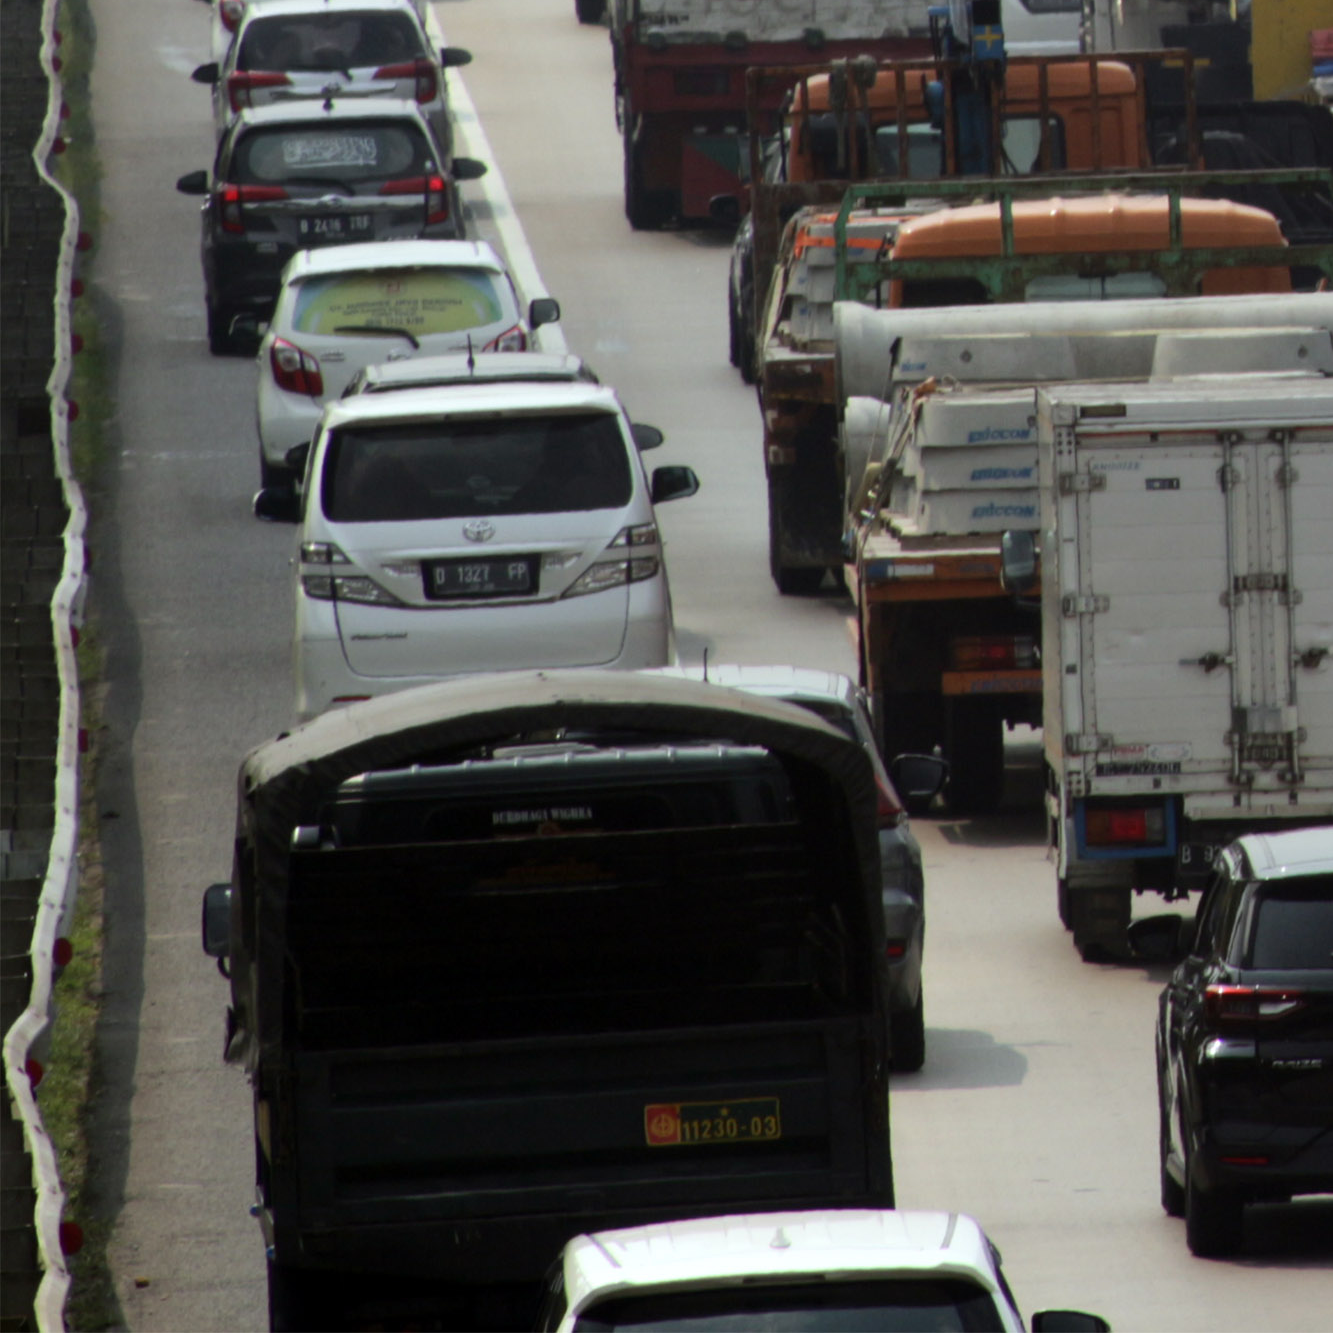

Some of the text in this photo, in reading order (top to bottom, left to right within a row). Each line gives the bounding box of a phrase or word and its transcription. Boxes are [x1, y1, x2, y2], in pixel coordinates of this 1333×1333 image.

[458, 563, 490, 584] 1327
[507, 560, 527, 580] FP
[1182, 844, 1191, 864] B
